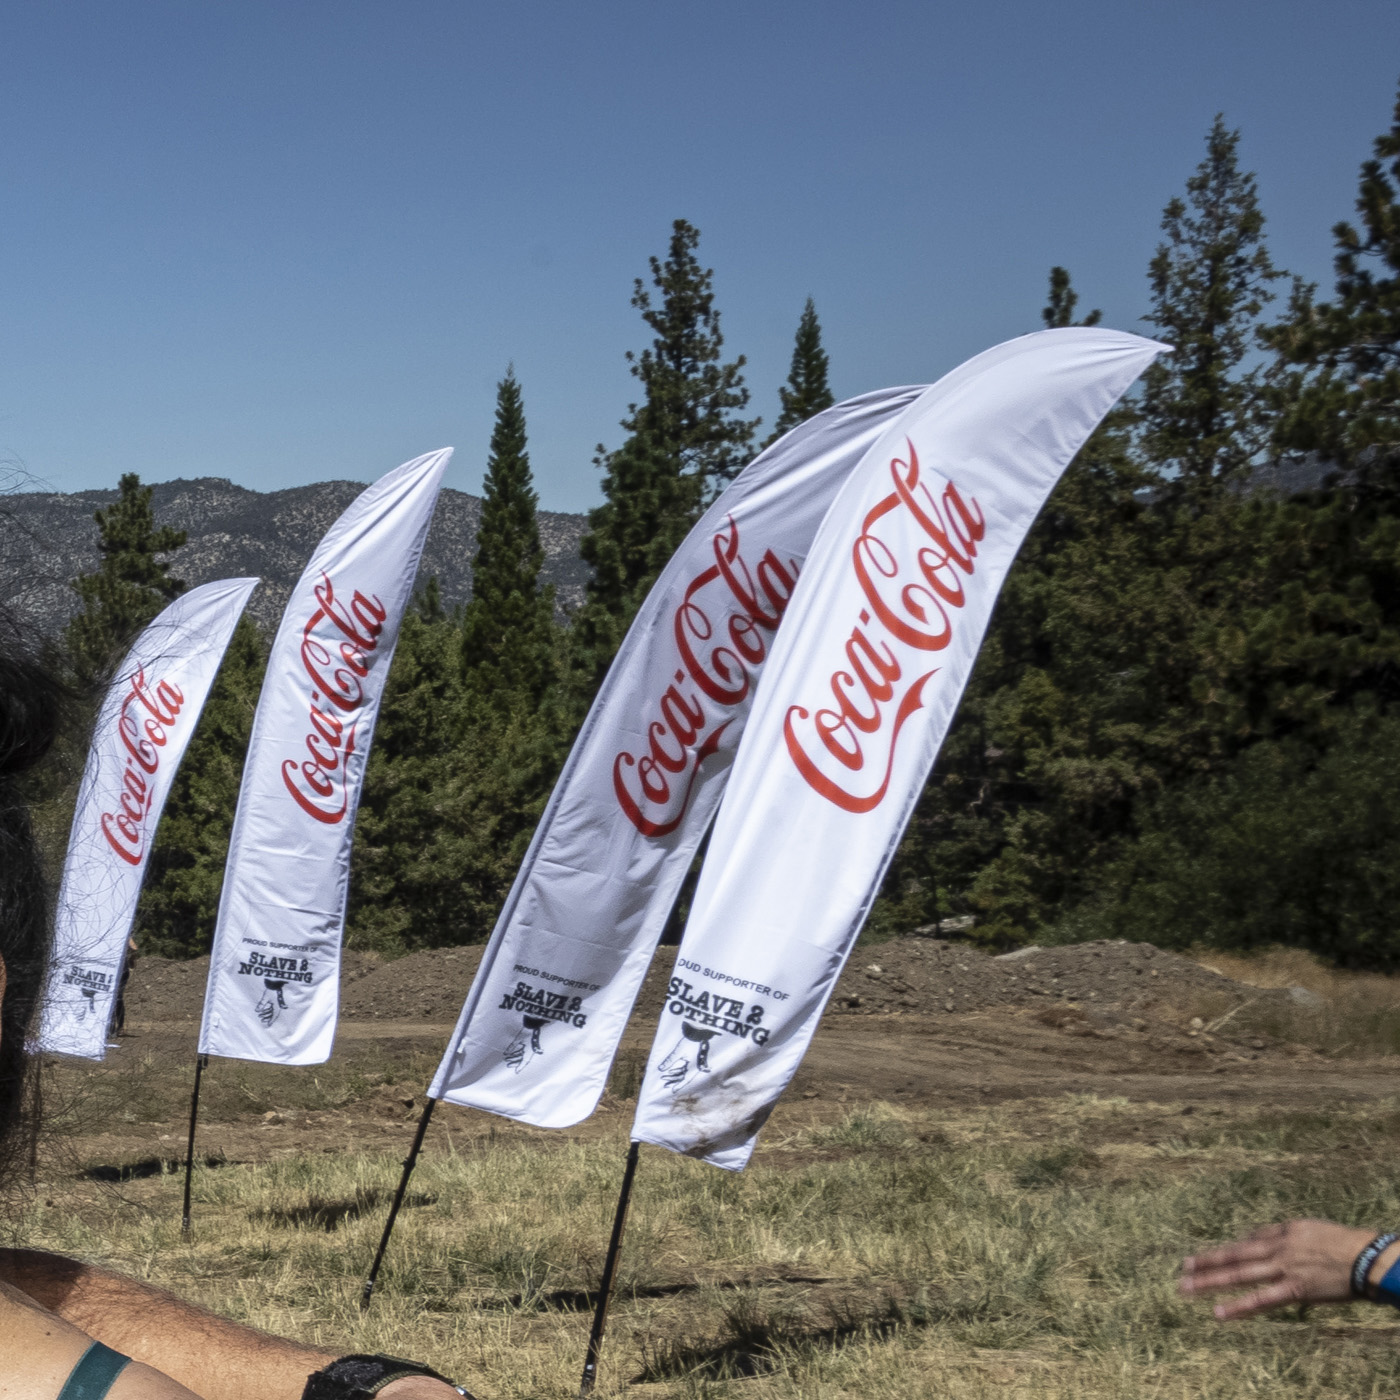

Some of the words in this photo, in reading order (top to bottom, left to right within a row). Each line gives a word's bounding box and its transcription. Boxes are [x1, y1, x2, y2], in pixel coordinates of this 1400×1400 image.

[784, 436, 986, 813] Coca-Cola
[613, 514, 800, 837] Coca-Cola
[282, 570, 387, 824] Coca-Cola
[101, 664, 184, 866] Coca-Cola
[238, 962, 313, 983] NOTHING
[249, 951, 297, 971] SLAVE
[513, 964, 539, 976] PROUD
[540, 971, 589, 989] SUPPORTER
[514, 981, 568, 1009] SLAVE
[568, 996, 582, 1012] 2
[668, 976, 744, 1019] SLAVE
[746, 1005, 764, 1025] 2
[703, 968, 771, 996] SUPPORTER
[773, 990, 790, 1001] OF
[499, 994, 587, 1028] NOTHING
[666, 995, 770, 1046] OTHING
